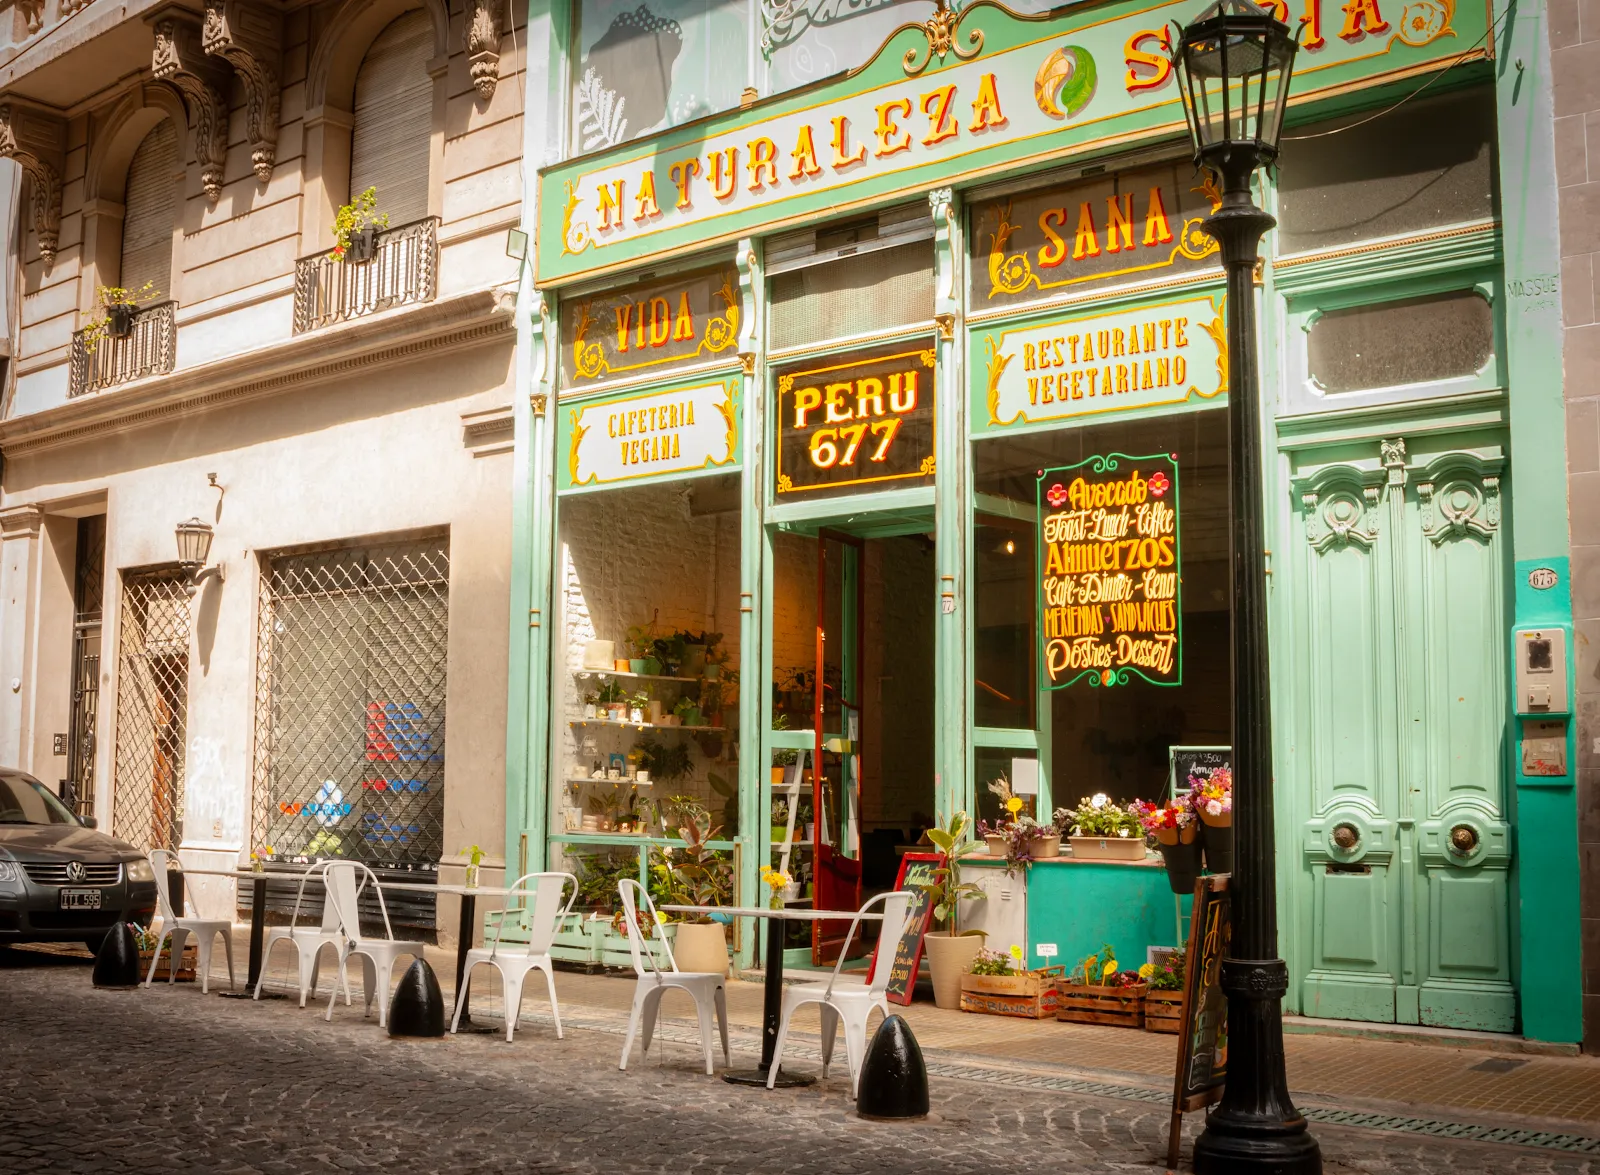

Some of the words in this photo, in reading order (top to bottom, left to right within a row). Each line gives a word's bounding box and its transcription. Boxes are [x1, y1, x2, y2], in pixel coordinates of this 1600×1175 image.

[595, 73, 1009, 233] NATURALEZA
[1037, 186, 1175, 269] SANA
[615, 290, 695, 354] VIDA
[1022, 317, 1190, 373] RESTAURANTE
[793, 371, 919, 429] PERU
[1026, 354, 1187, 406] VEGETARIANO
[608, 400, 695, 440] CAFETERIA
[809, 418, 904, 471] 677
[620, 433, 681, 466] VEGANA
[1068, 470, 1148, 510] Avocado
[1533, 573, 1553, 585] 675
[84, 894, 100, 906] 595
